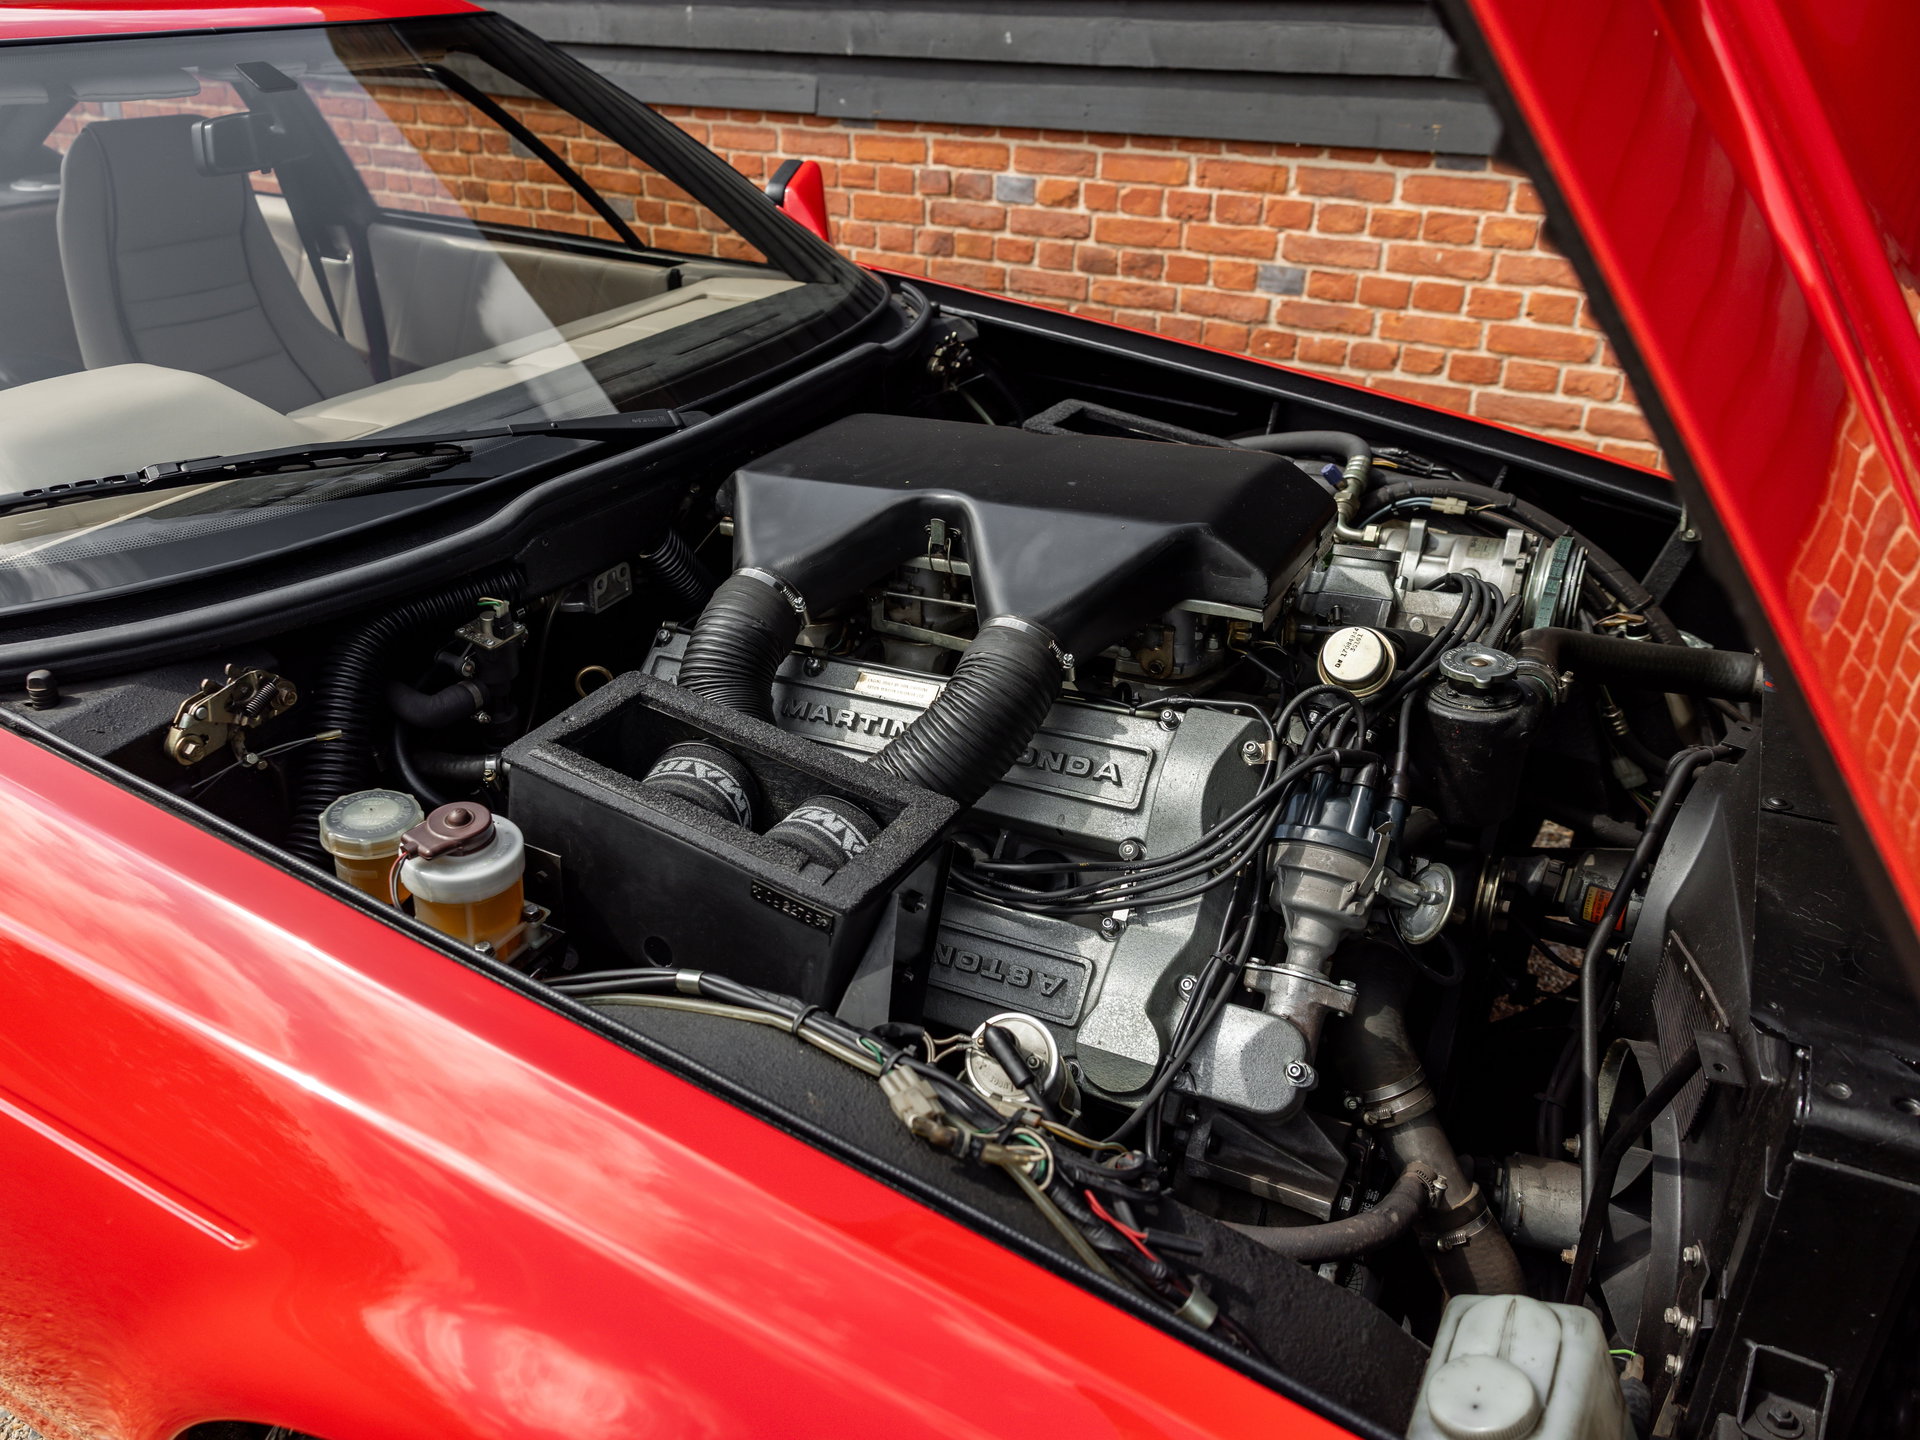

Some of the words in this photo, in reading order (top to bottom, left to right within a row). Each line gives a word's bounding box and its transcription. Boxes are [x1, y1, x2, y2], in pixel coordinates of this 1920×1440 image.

[782, 701, 907, 738] MARTIN
[1016, 747, 1123, 788] ONDA
[933, 943, 1069, 998] ASTON
